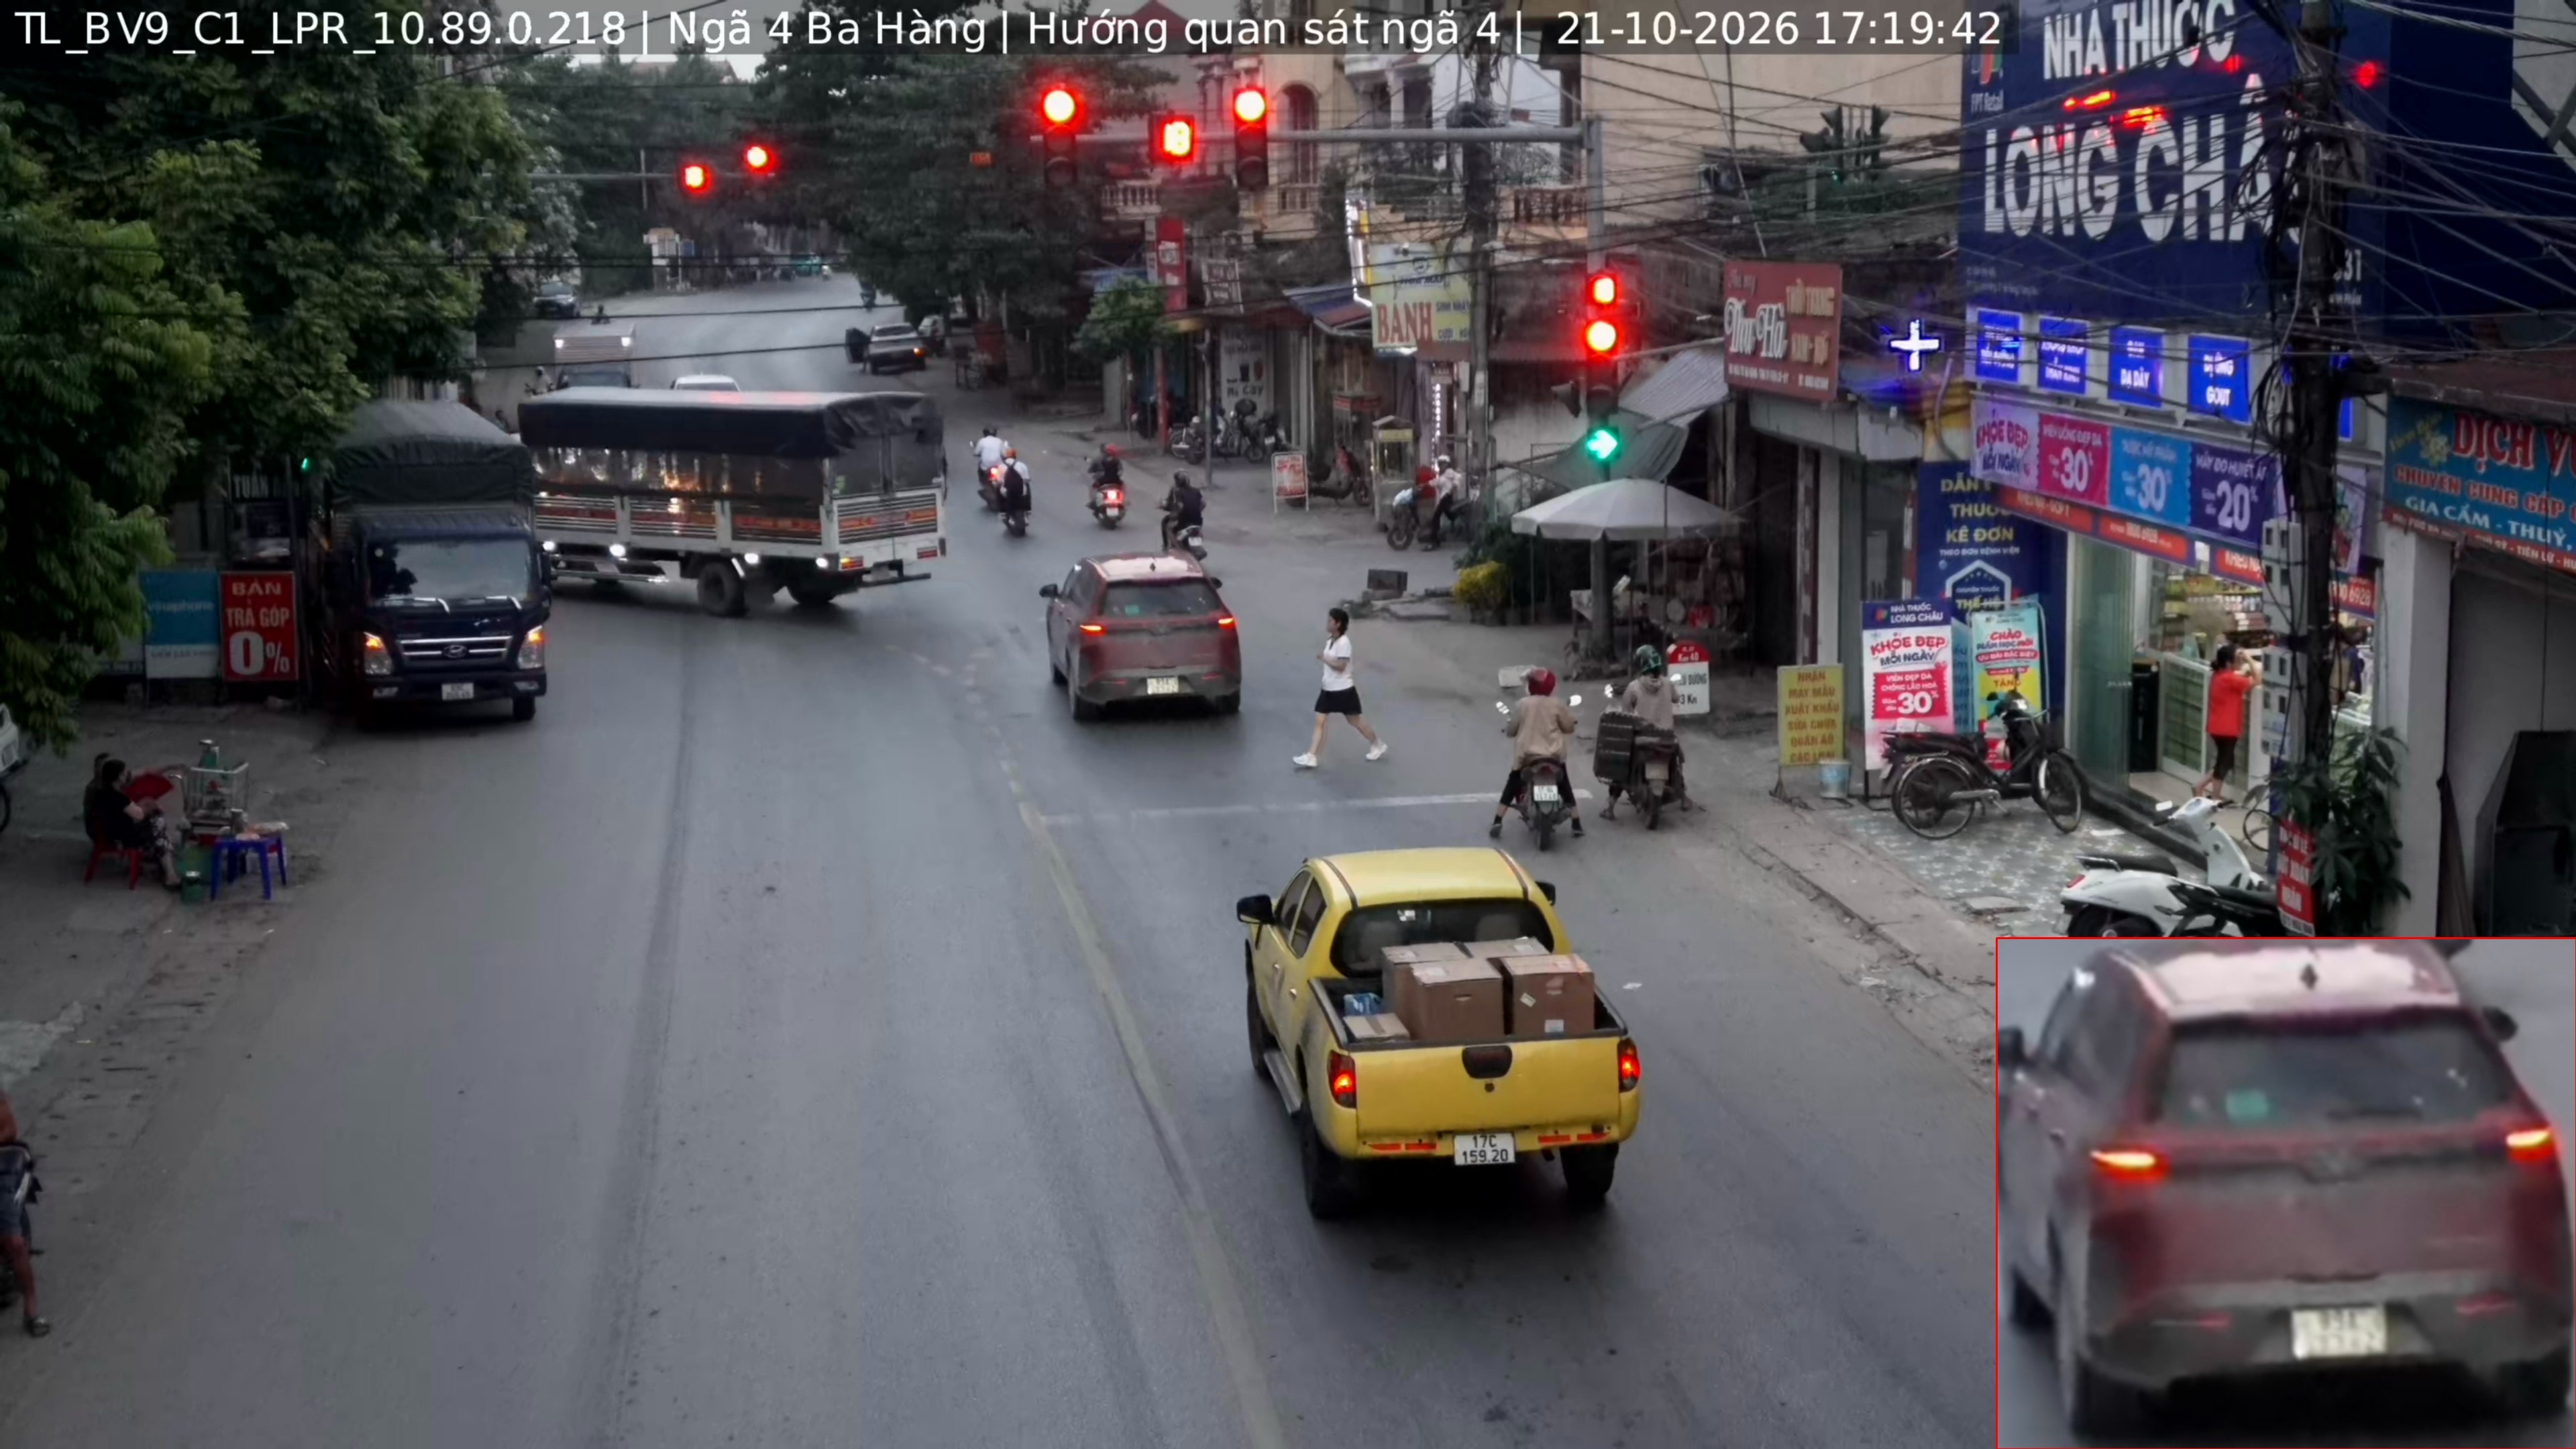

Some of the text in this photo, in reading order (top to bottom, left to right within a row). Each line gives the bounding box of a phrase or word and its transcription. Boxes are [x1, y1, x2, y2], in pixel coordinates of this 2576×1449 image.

[1984, 72, 2301, 242] LONG CHÂ
[2205, 384, 2231, 408] GOUT
[2452, 411, 2536, 474] DỊCH
[2545, 427, 2576, 480] V
[2405, 495, 2440, 517] GIA
[2466, 480, 2518, 509] CUNG
[2524, 487, 2566, 519] CẤP
[1946, 525, 2014, 543] KÊ ĐƠN
[1939, 548, 1960, 557] THEO
[226, 599, 290, 629] TRẢ GÓP
[1890, 602, 1932, 612] NHÀ THUỐC
[1890, 611, 1943, 624] LONG CHÂU
[1915, 635, 1947, 651] ĐẸP
[229, 631, 290, 676] 0%
[1903, 648, 1935, 662] NGÀY
[1921, 672, 1933, 680] DA
[1472, 1134, 1497, 1148] 17C
[1462, 1148, 1509, 1164] 159.20
